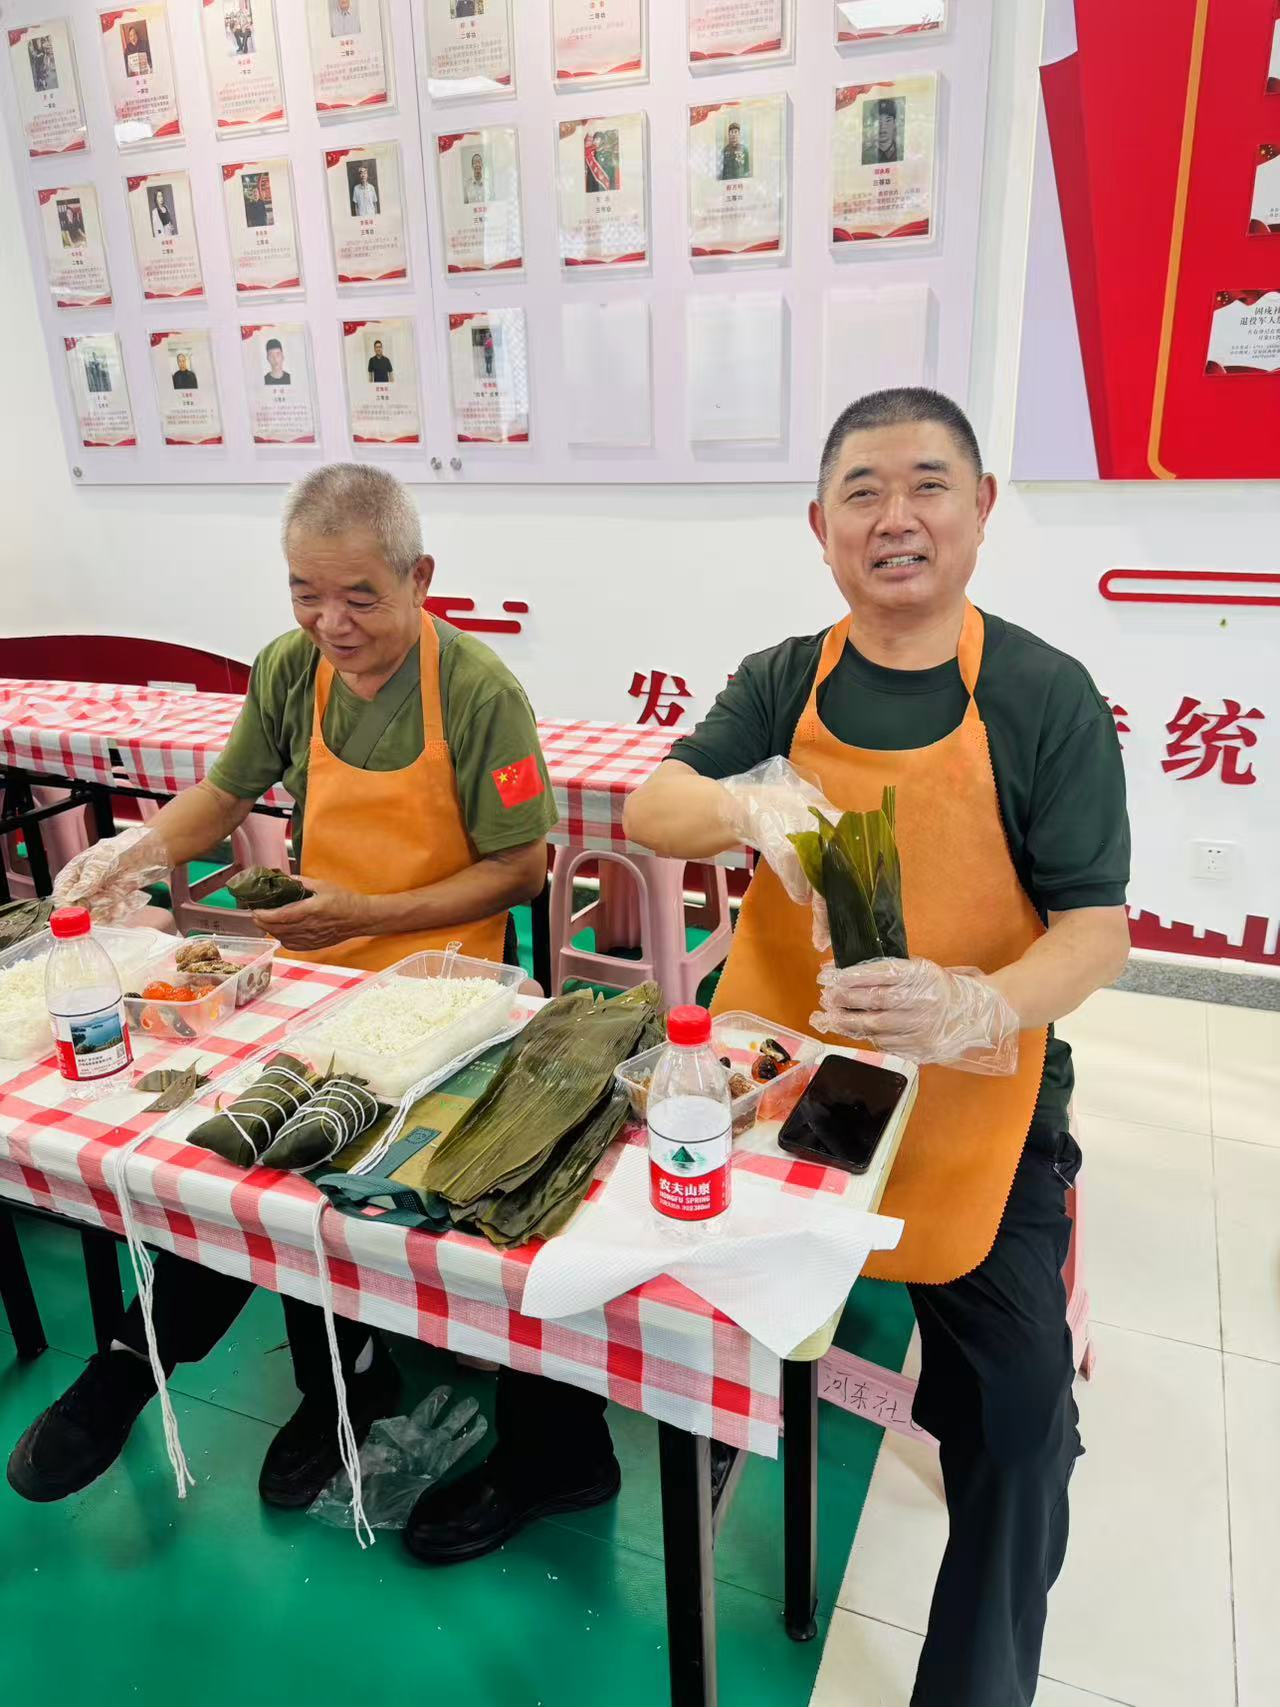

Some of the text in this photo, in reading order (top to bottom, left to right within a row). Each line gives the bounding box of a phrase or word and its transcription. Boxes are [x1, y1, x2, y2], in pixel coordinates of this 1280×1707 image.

[627, 670, 692, 726] 发
[659, 1178, 711, 1196] 农夫山泉
[685, 1195, 711, 1204] SPRING
[824, 1360, 923, 1432] 河东社
